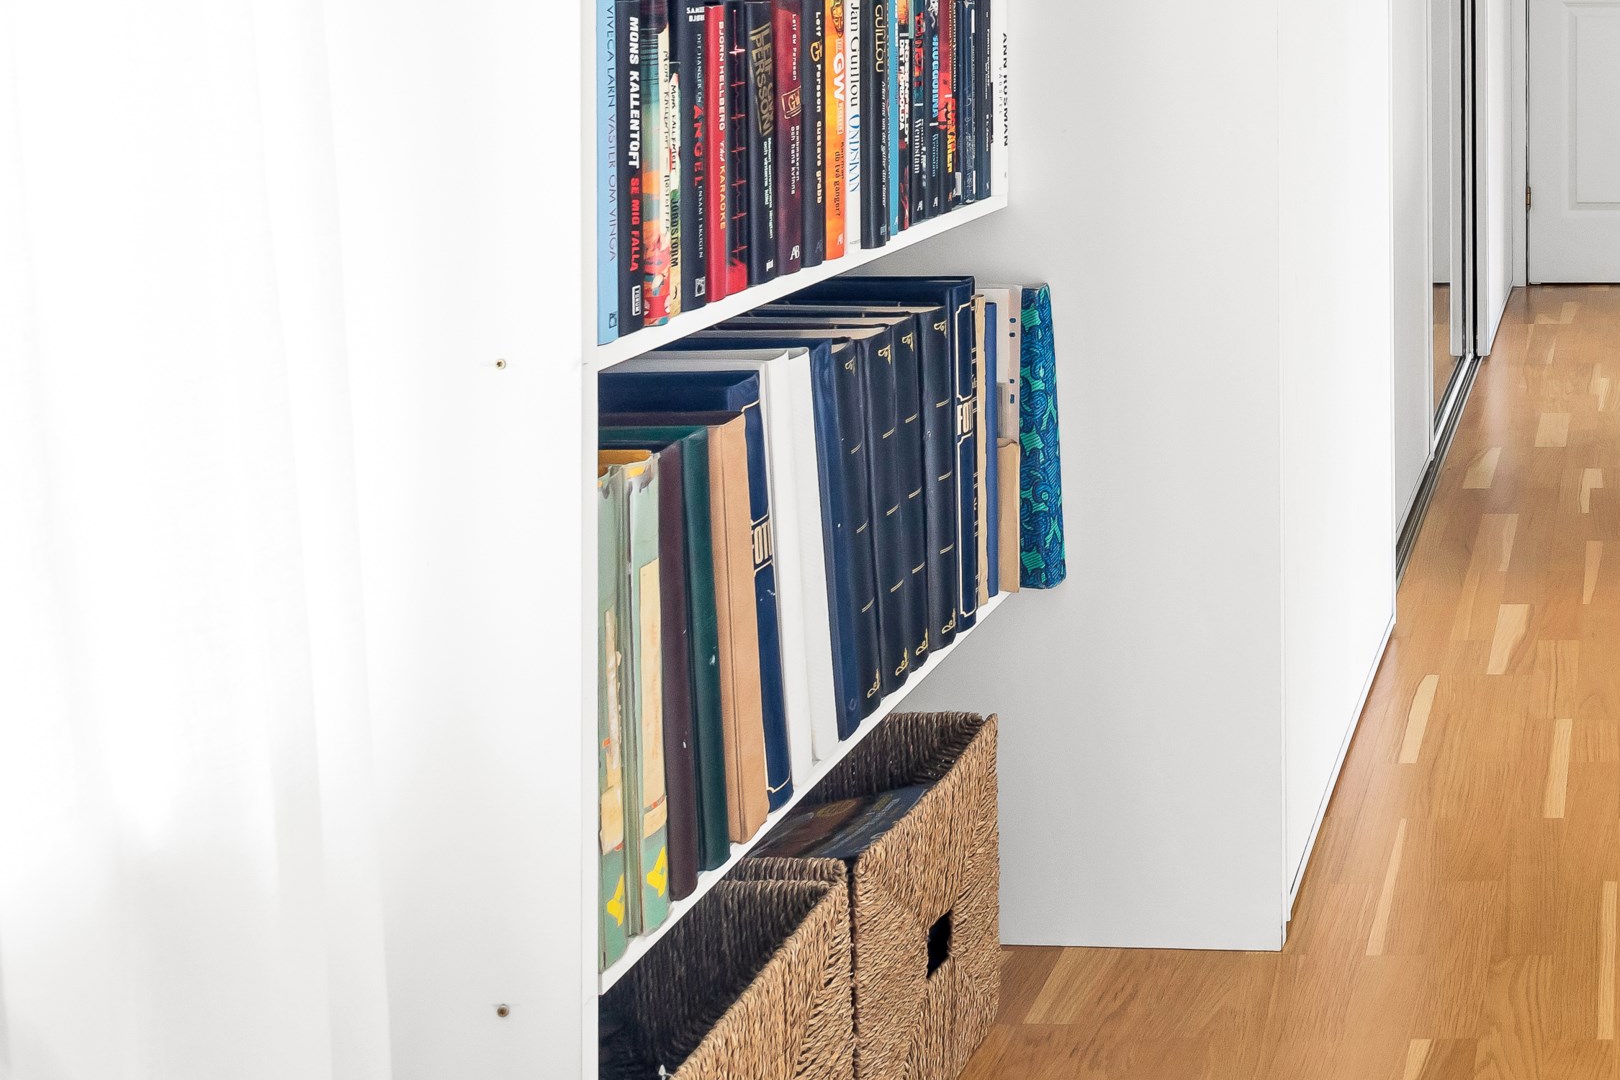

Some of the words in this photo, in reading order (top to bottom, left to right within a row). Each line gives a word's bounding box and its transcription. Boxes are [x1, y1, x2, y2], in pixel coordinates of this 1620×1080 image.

[606, 5, 615, 62] VIVECA
[629, 16, 639, 65] MONS
[850, 2, 859, 32] Jan
[875, 4, 887, 73] GUILLOU
[750, 32, 771, 133] PERSSON
[833, 52, 845, 102] GW
[850, 36, 860, 107] Guillou
[628, 70, 640, 169] KALLENTOFT
[914, 118, 922, 174] Wennstam
[848, 114, 861, 193] ONDSKAN
[608, 175, 616, 204] OM
[630, 177, 640, 195] SE
[630, 199, 640, 226] MIG
[833, 180, 841, 217] gånger?
[608, 208, 616, 263] VINGA
[629, 230, 640, 272] FALLA
[670, 198, 679, 267] JORDSTORM
